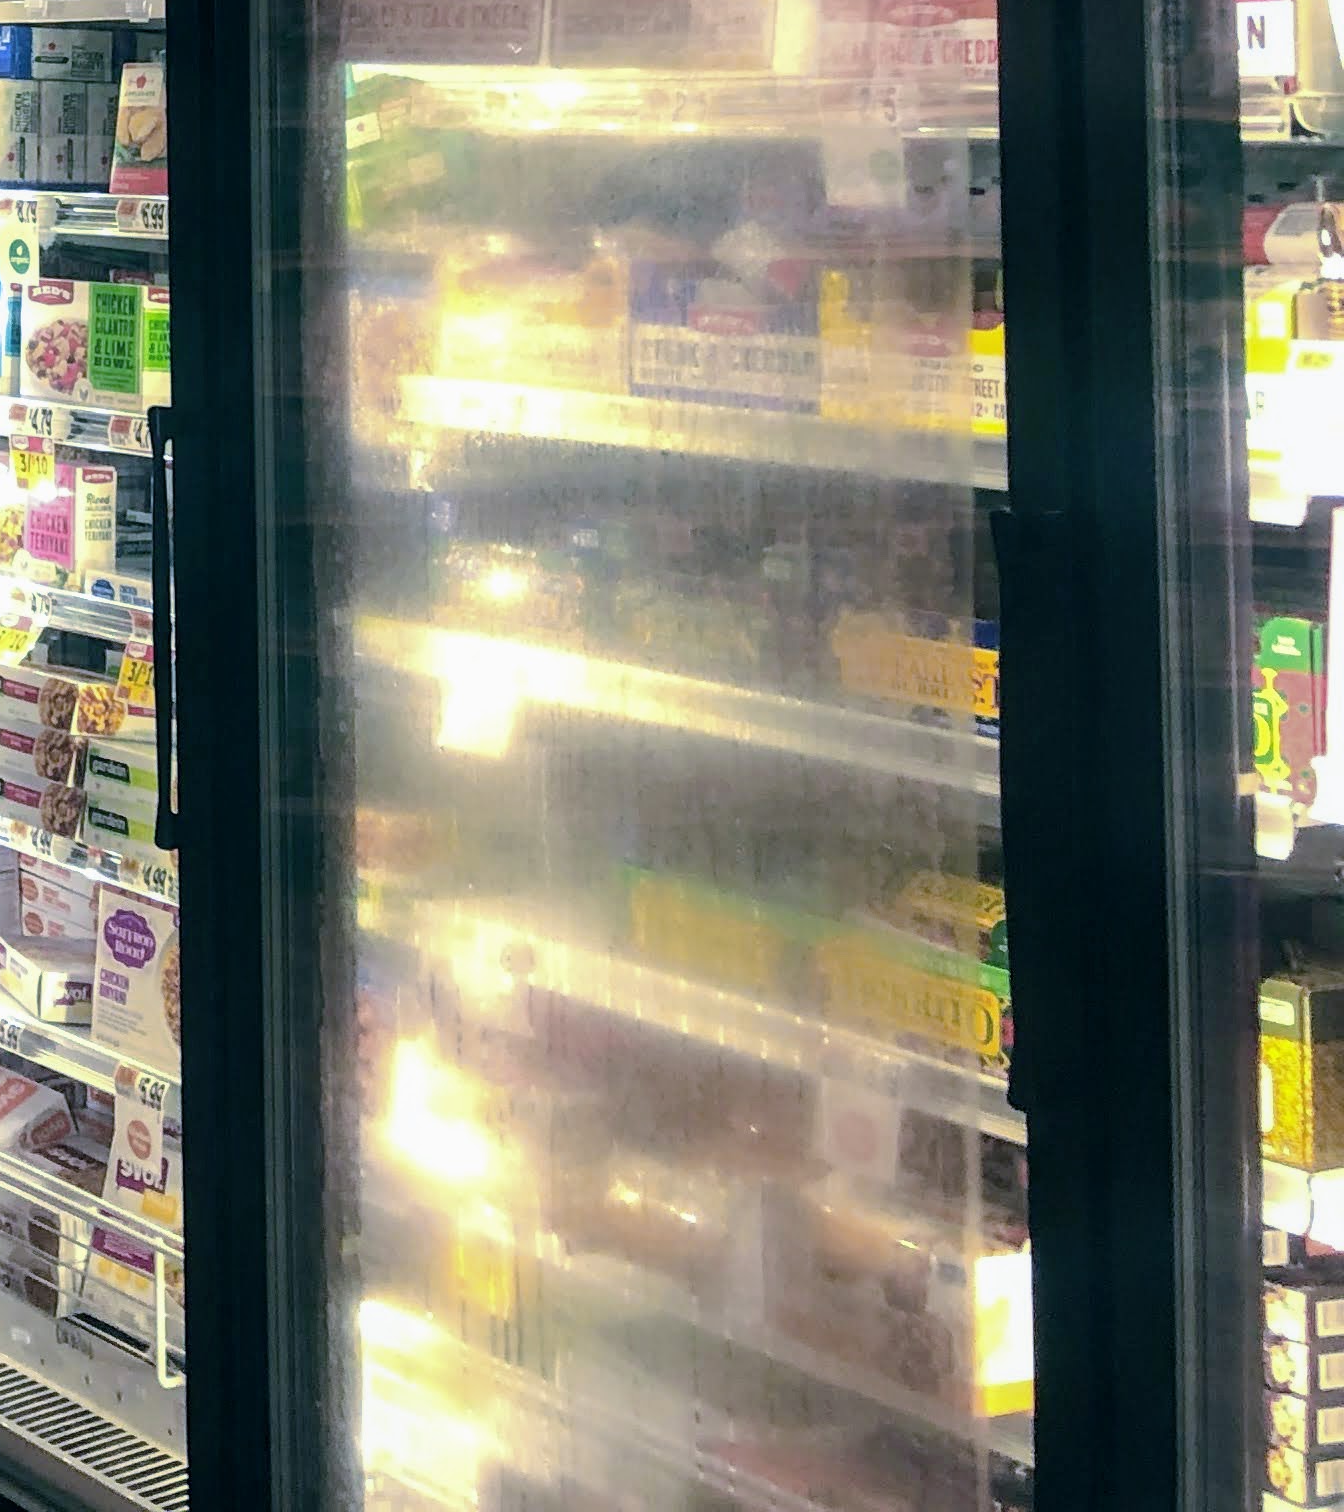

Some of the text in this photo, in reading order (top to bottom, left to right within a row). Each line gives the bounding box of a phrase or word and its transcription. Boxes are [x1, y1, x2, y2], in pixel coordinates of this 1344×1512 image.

[942, 39, 998, 65] CHEDD
[96, 294, 136, 316] CHICKEN
[95, 317, 135, 338] CILANTRO
[105, 340, 134, 358] LIME
[93, 356, 134, 370] BOWL
[30, 510, 69, 535] CHICKEN
[30, 531, 70, 555] TERIYAKI
